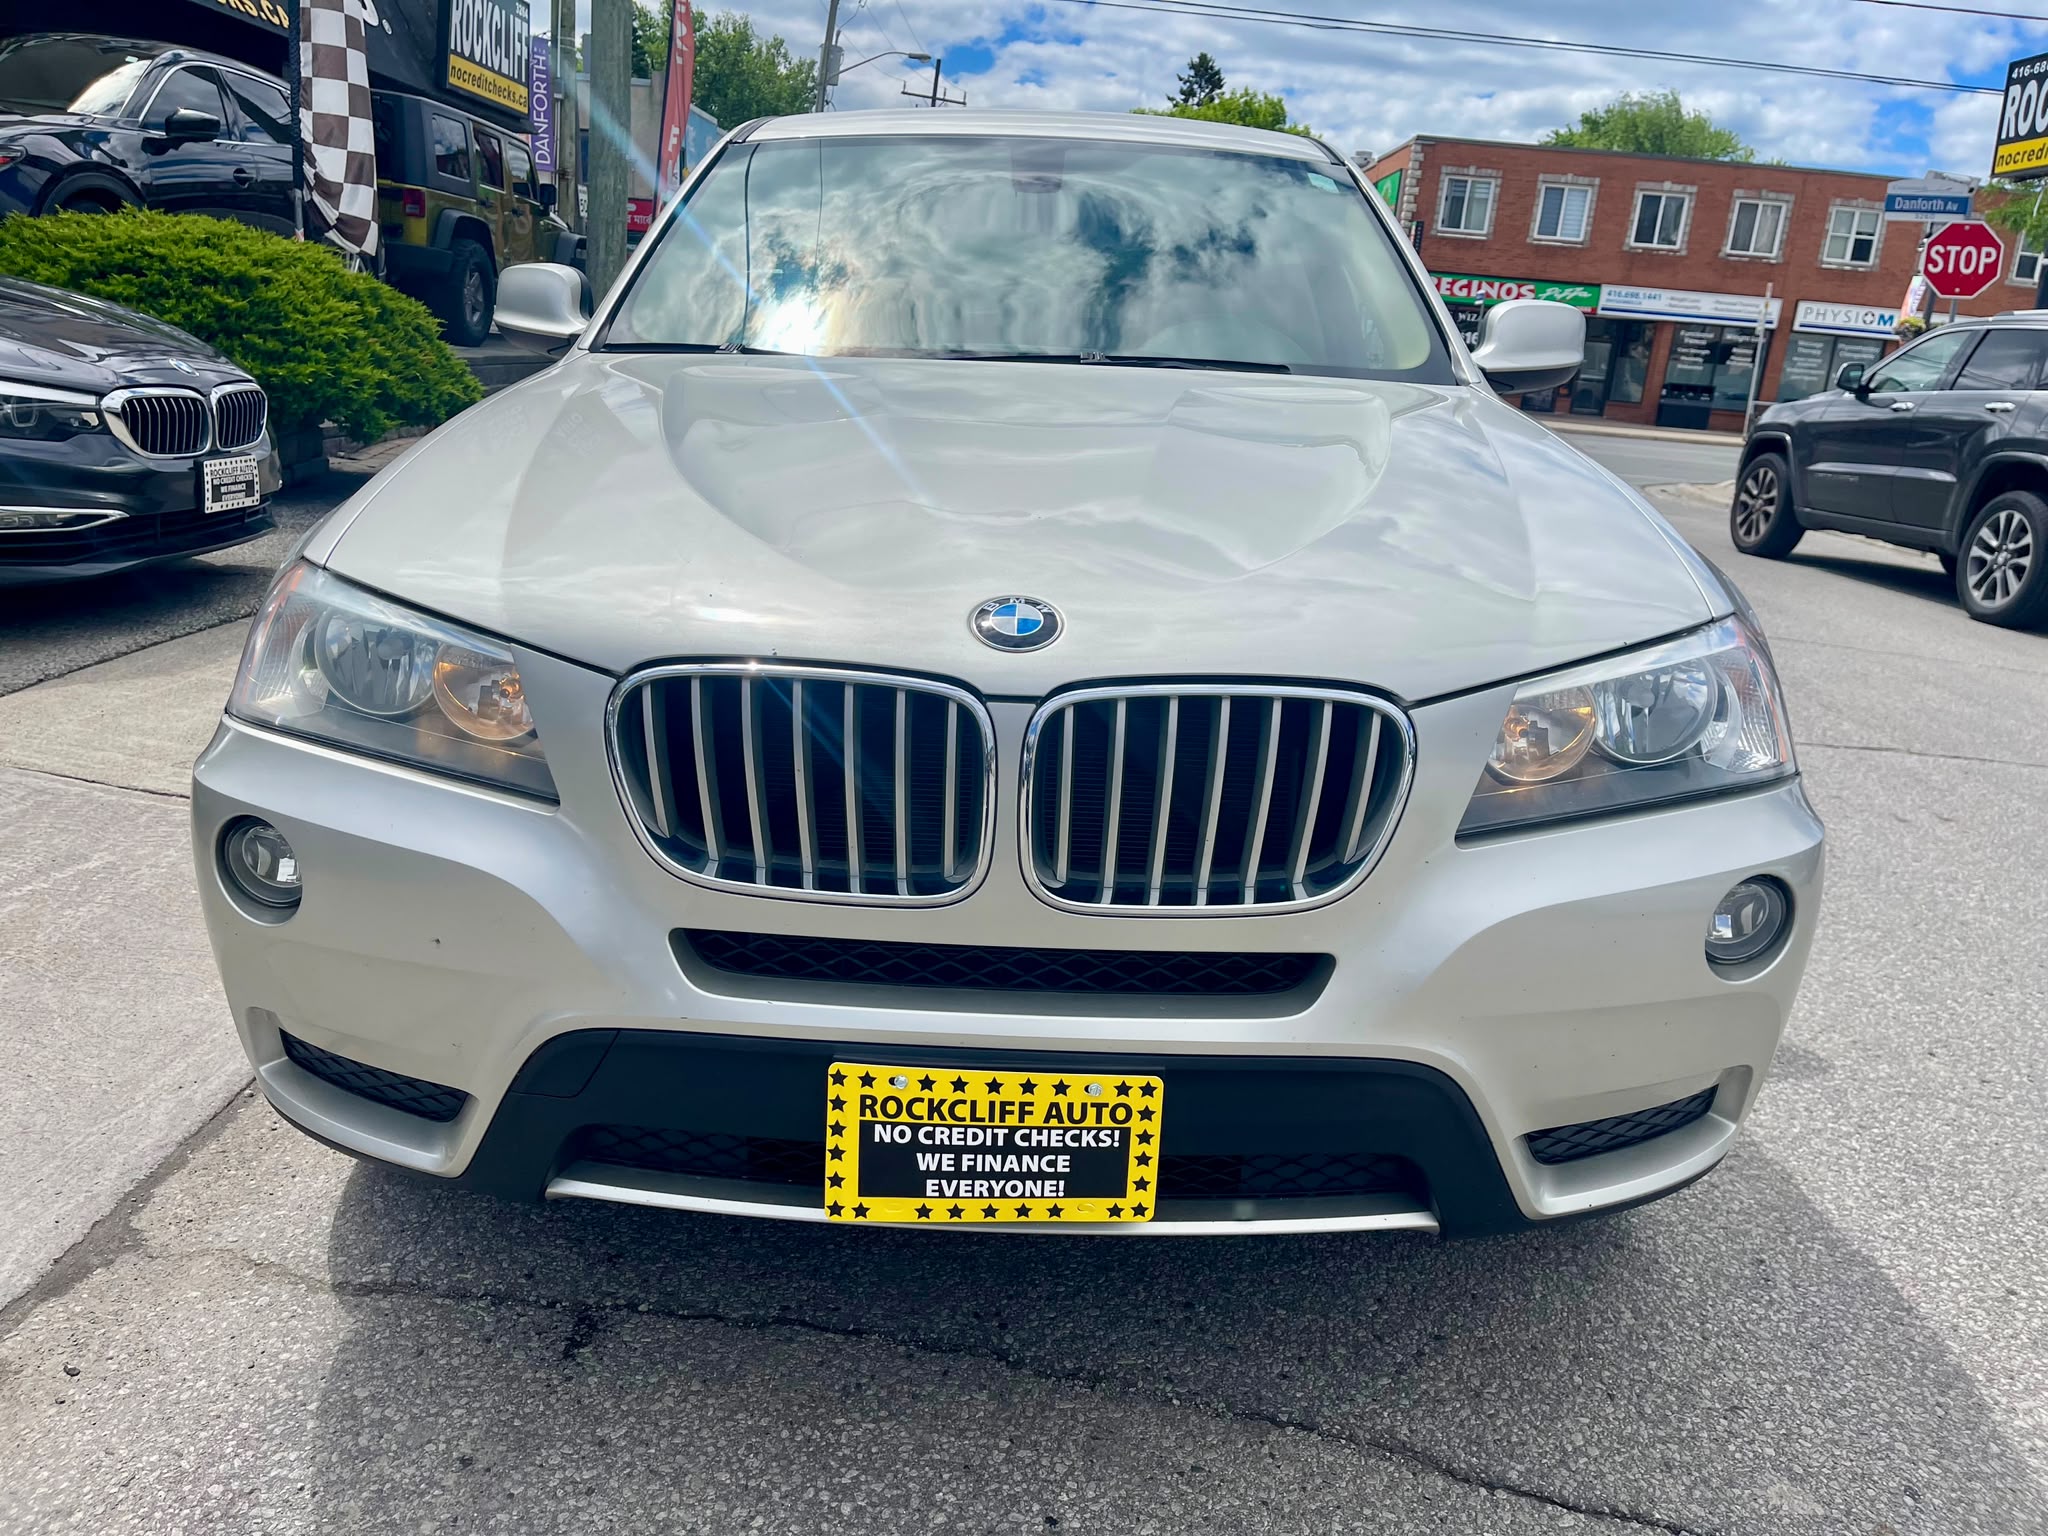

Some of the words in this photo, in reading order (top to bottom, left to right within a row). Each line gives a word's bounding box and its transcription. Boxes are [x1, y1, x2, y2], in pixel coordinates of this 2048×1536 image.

[450, 0, 529, 82] ROCKCLIFF
[2012, 62, 2048, 79] 416-68
[450, 64, 528, 108] nocreditchecks.ca
[533, 55, 550, 165] DANFORTH
[1894, 196, 1945, 212] Danforth
[1945, 201, 1959, 212] Av
[1927, 245, 1997, 275] STOP
[210, 467, 238, 477] ROCKCLIFF
[982, 597, 1053, 613] BMW
[859, 1094, 1035, 1124] ROCKCLIFF
[1043, 1102, 1133, 1125] AUTO
[874, 1124, 912, 1144] NO
[917, 1126, 1009, 1147] CREDIT
[1014, 1129, 1120, 1148] CHECKS!
[916, 1152, 955, 1172] WE
[961, 1153, 1071, 1173] FINANCE
[925, 1179, 1065, 1197] EVERYONE!
